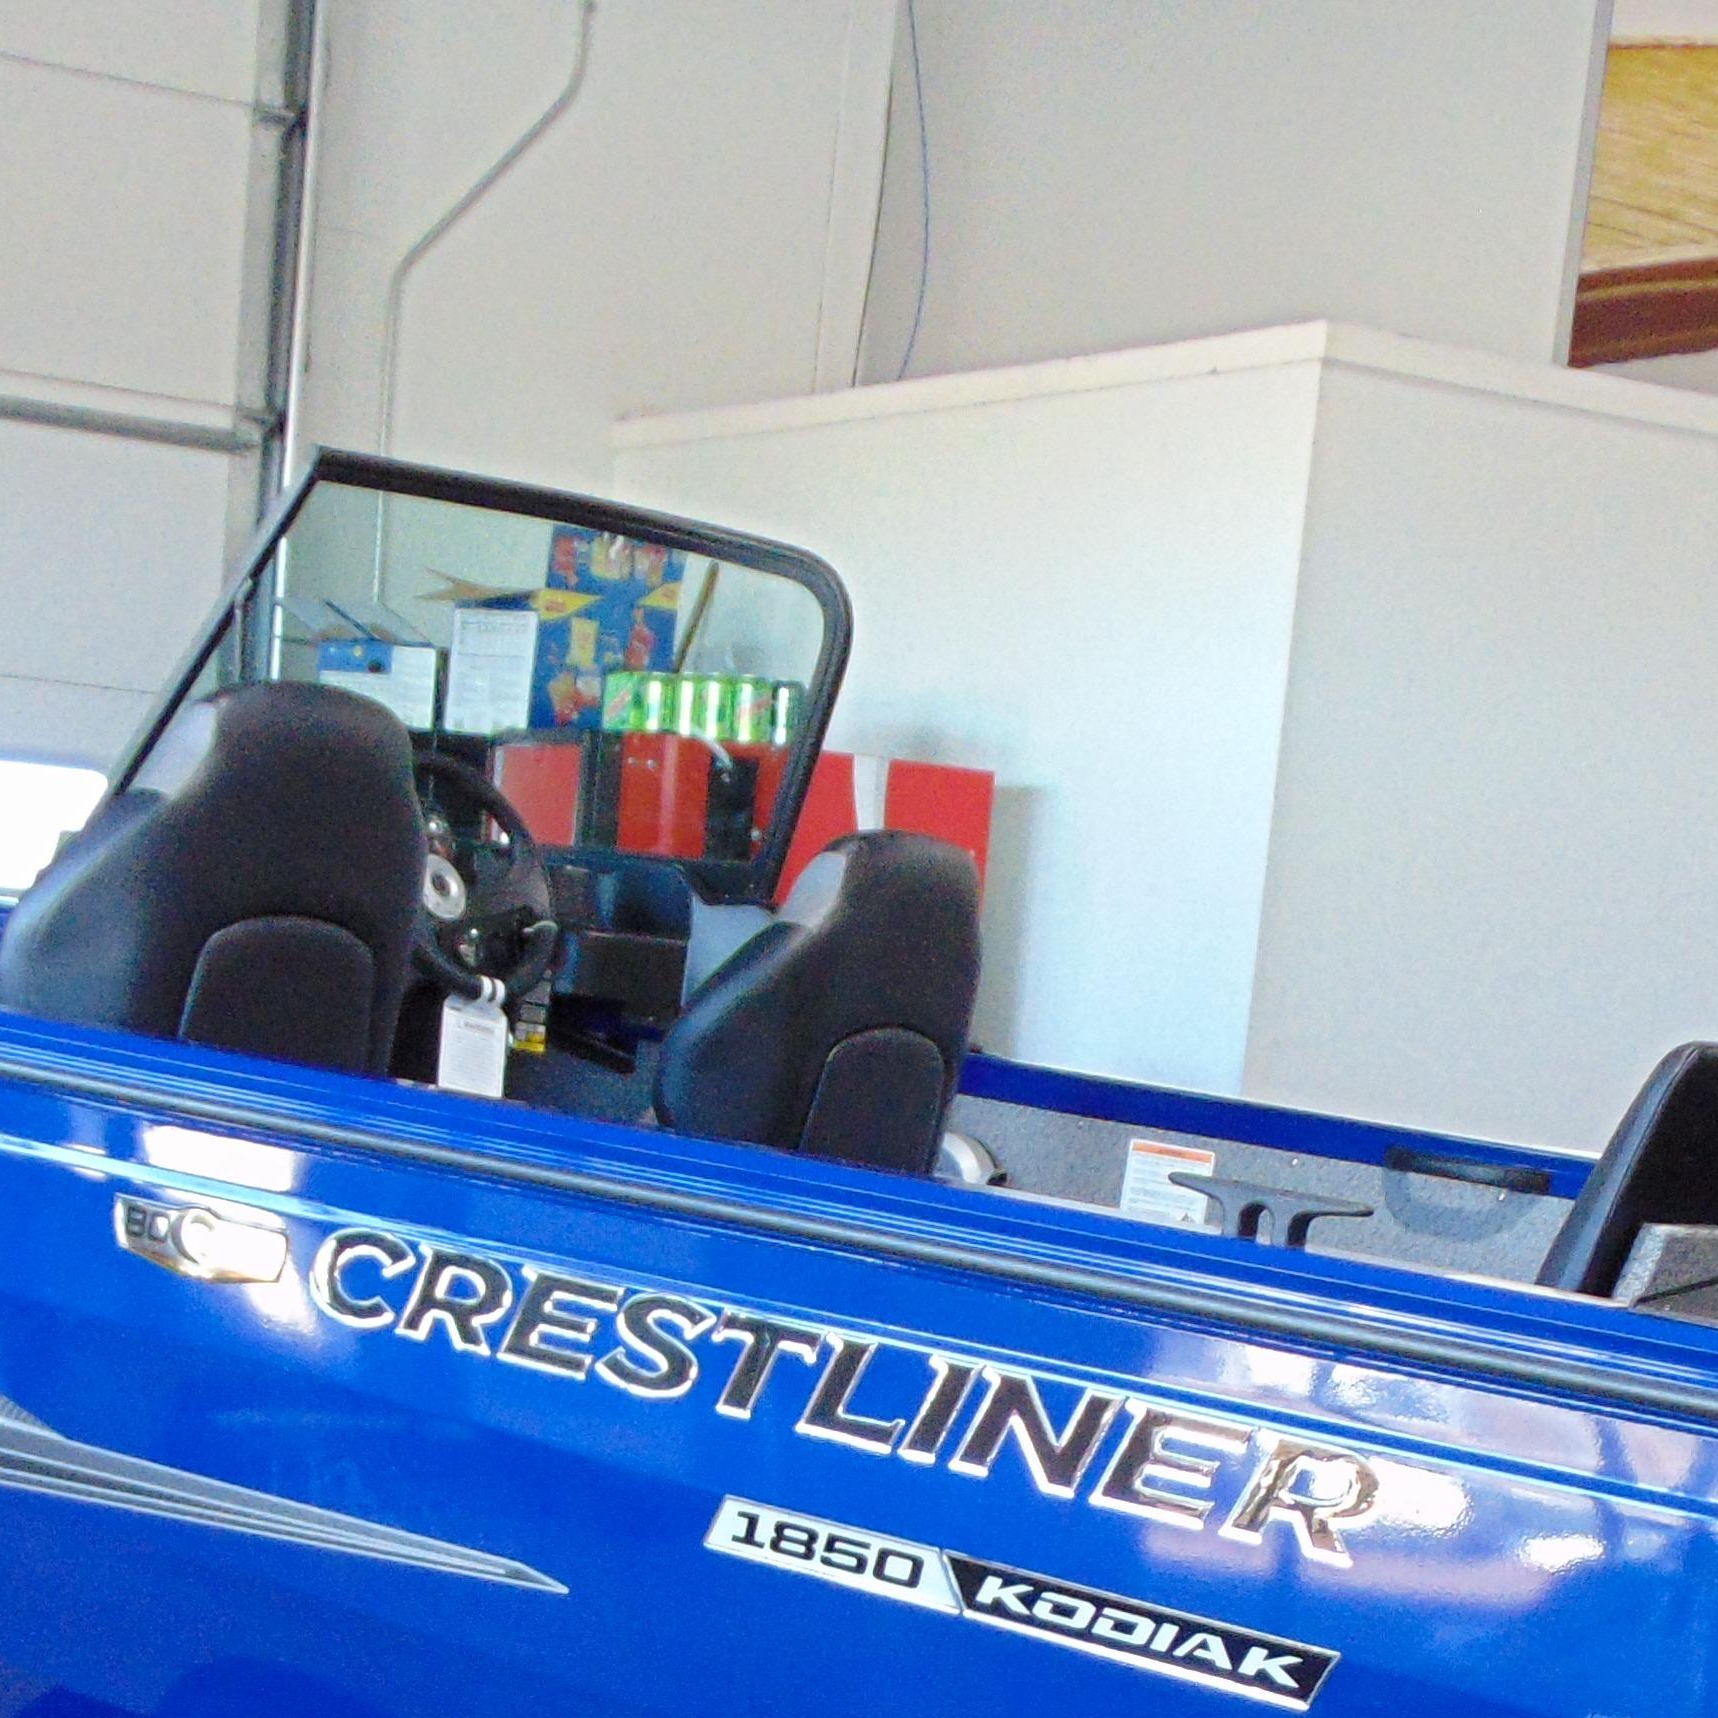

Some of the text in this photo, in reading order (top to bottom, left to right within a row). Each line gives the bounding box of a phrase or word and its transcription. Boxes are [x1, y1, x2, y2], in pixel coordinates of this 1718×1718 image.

[308, 1227, 1381, 1567] CRESTLINER
[730, 1510, 925, 1589] 1850
[974, 1575, 1304, 1689] KODIAK
